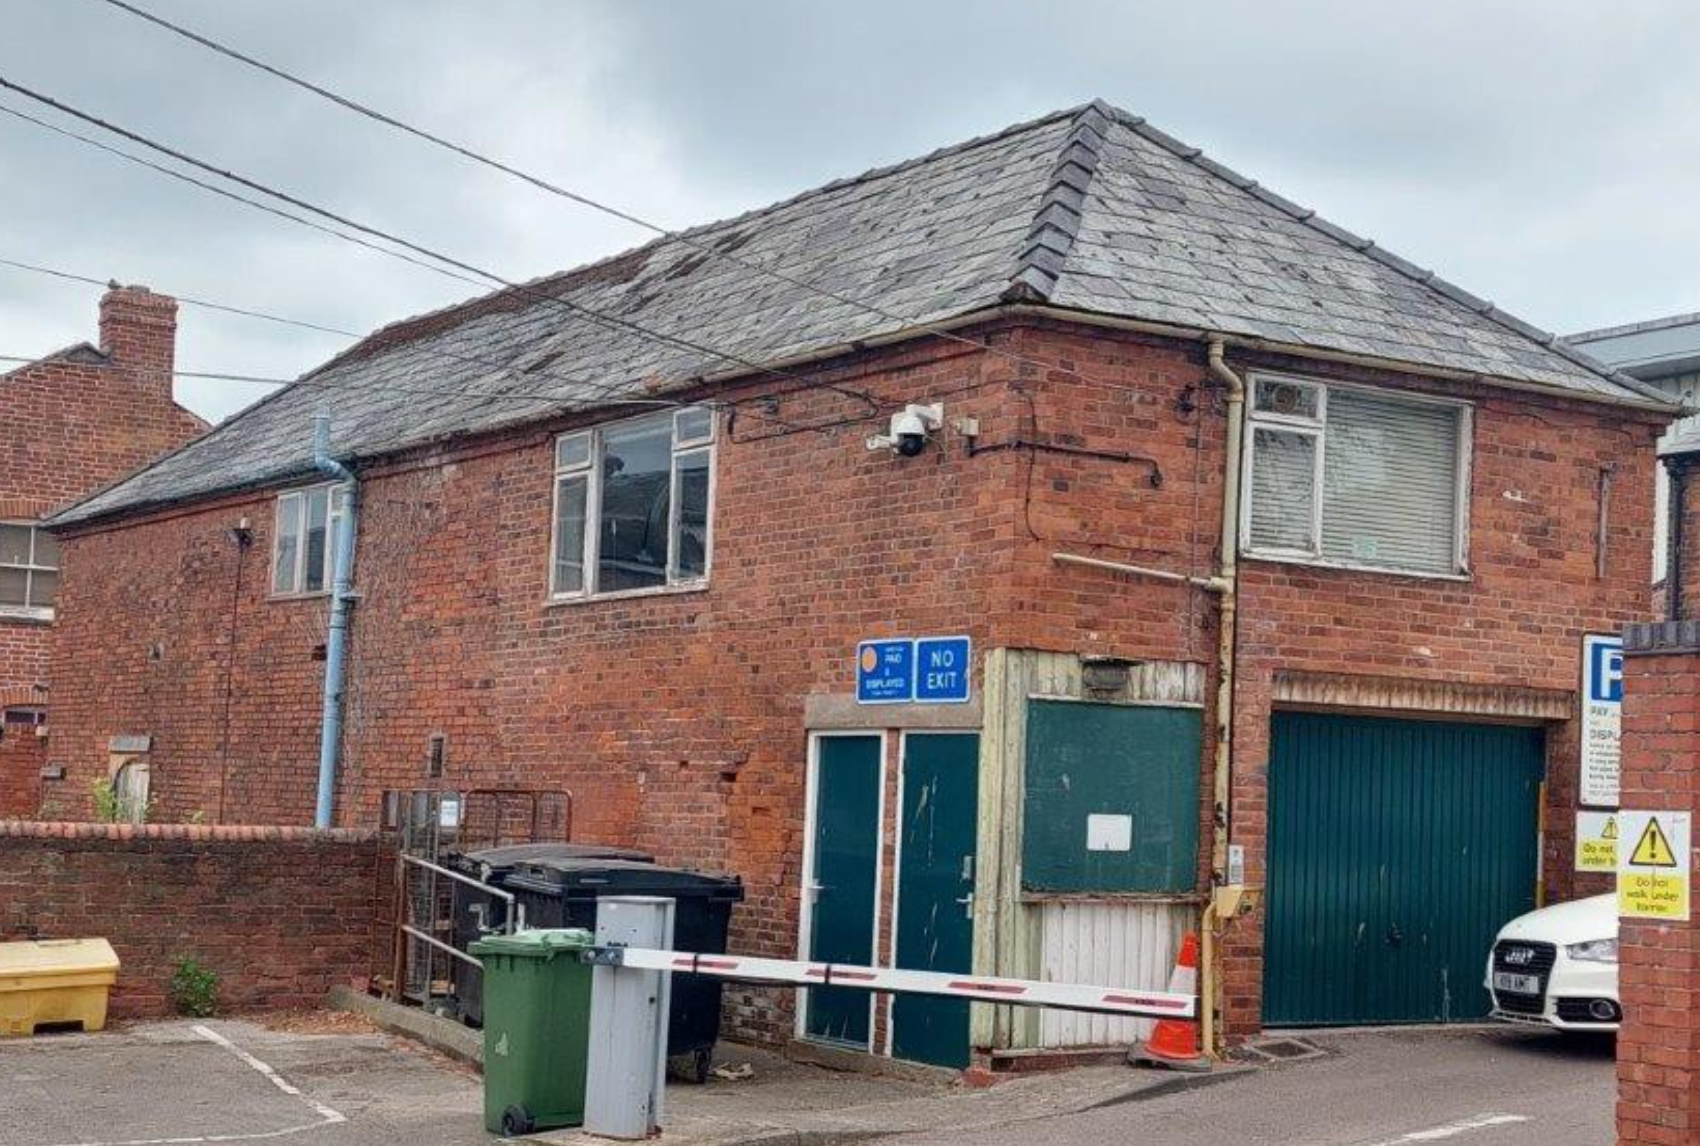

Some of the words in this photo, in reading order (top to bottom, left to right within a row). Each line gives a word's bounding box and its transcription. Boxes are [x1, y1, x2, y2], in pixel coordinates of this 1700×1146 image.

[931, 650, 954, 668] NO
[927, 671, 957, 689] EXIT
[1589, 706, 1608, 717] PAY
[1589, 730, 1620, 741] DISPL
[1636, 877, 1650, 887] Do
[1652, 891, 1679, 901] under
